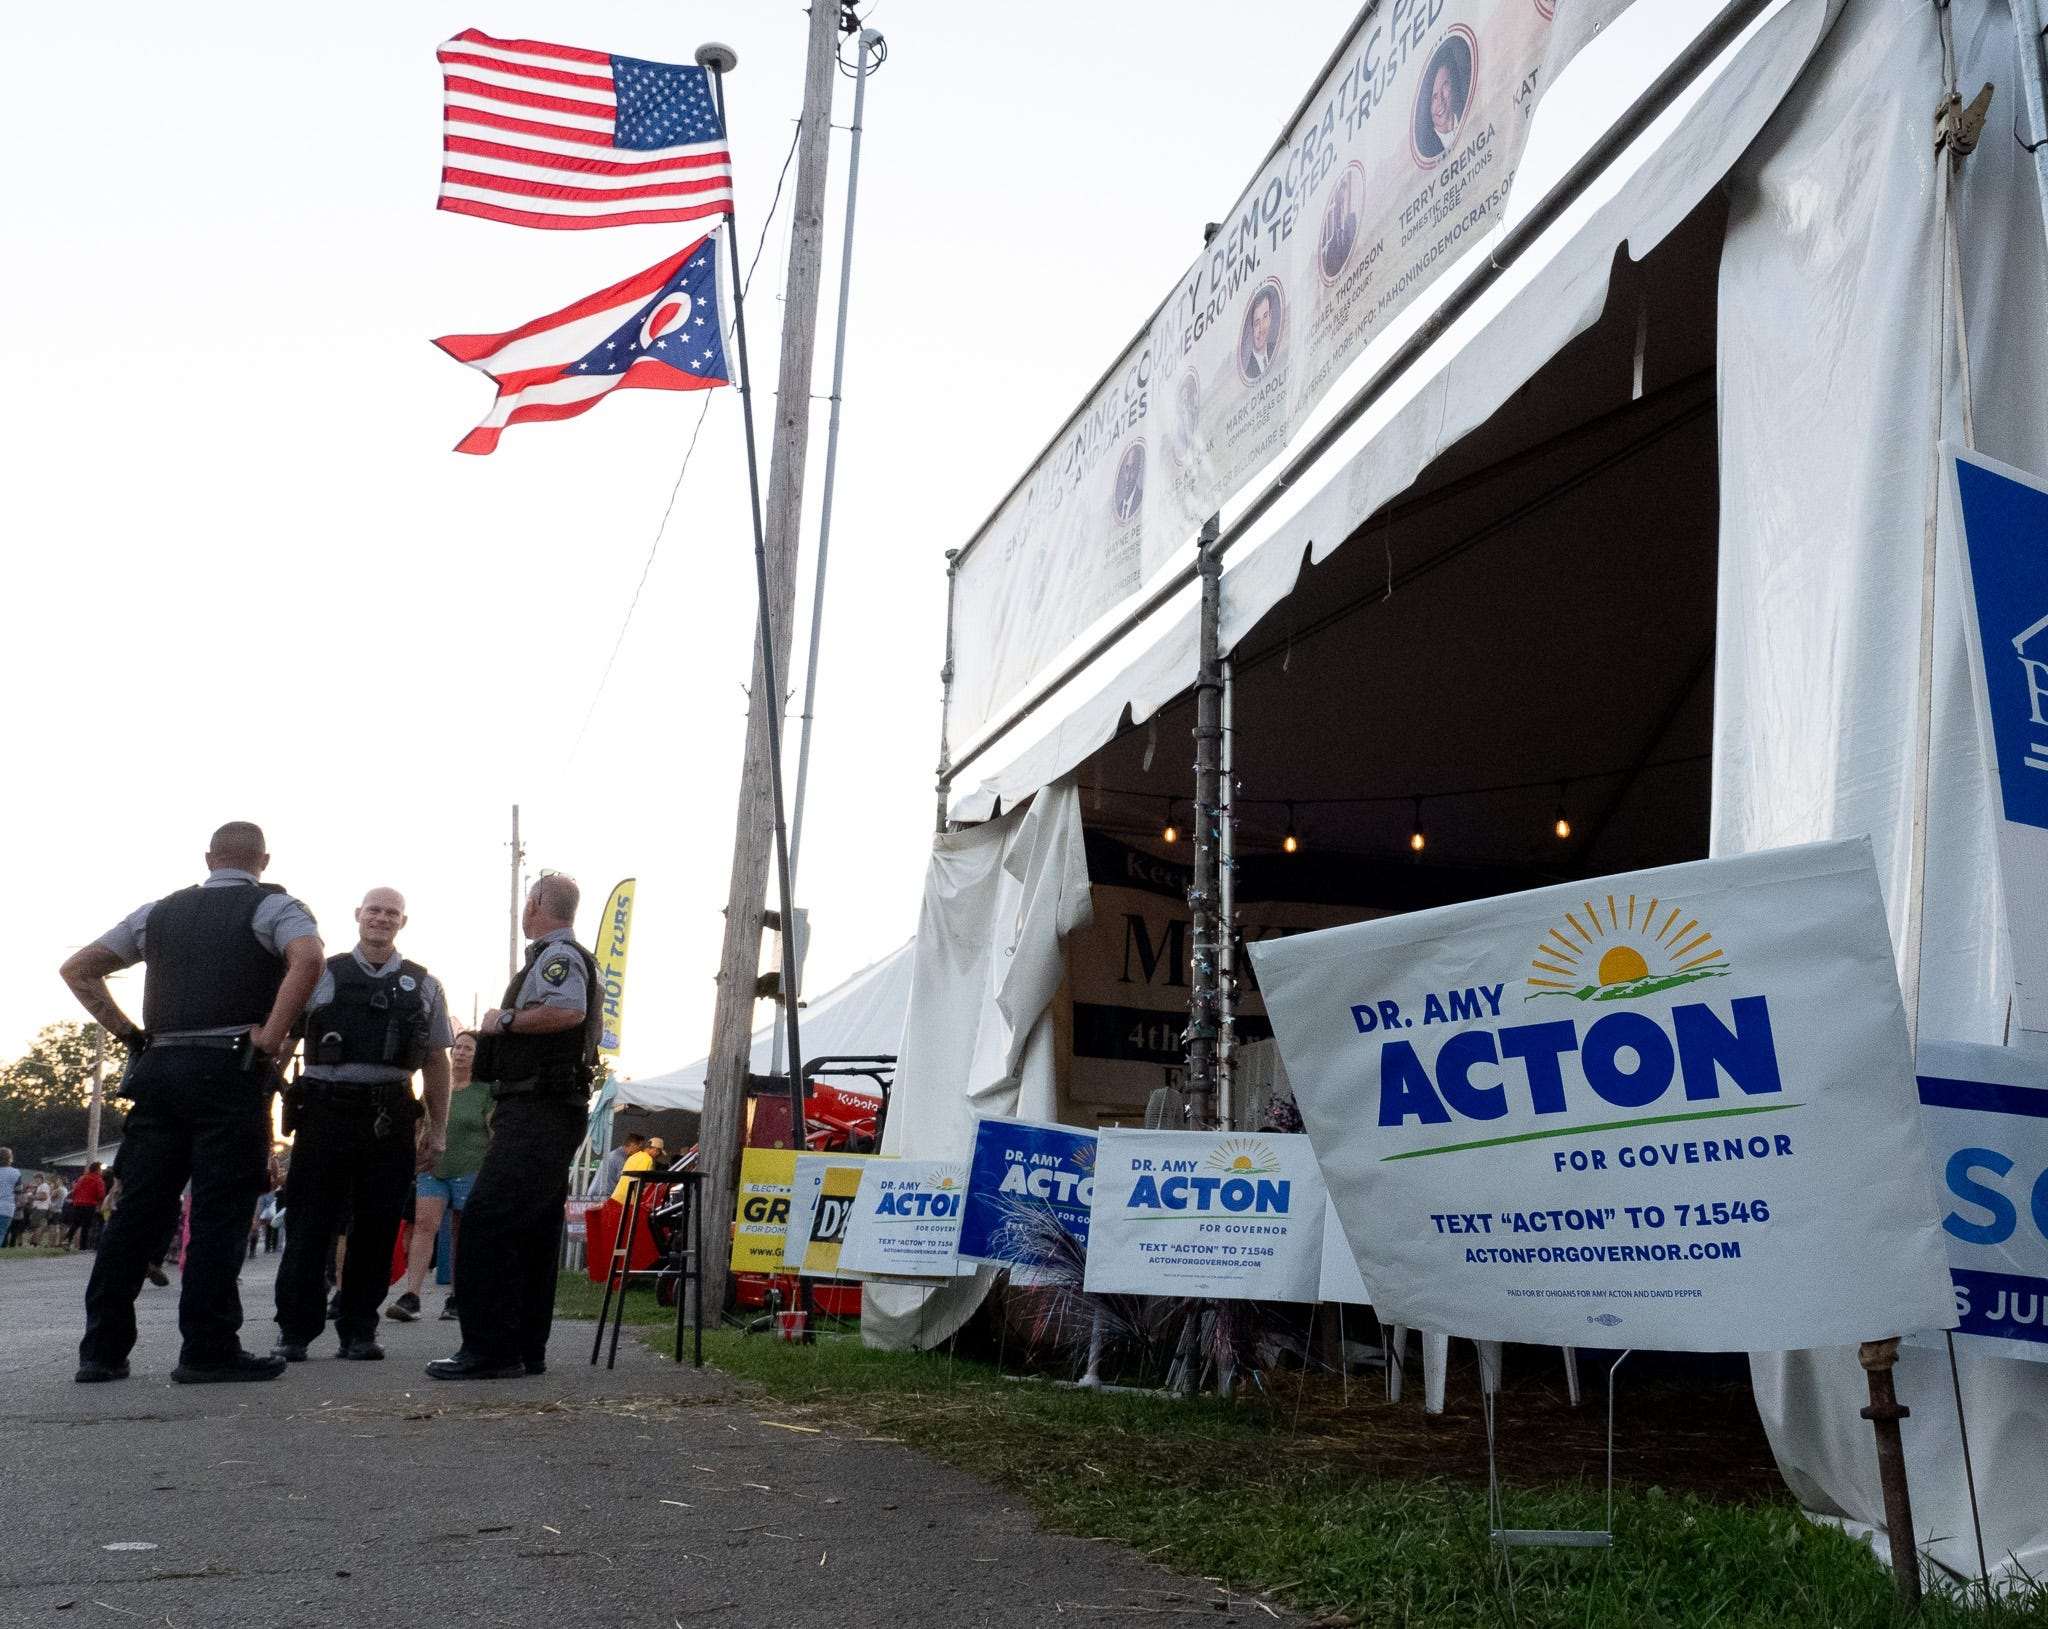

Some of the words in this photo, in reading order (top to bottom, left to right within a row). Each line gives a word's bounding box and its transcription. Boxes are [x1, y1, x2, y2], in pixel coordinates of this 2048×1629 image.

[1399, 180, 1436, 229] TERRY
[1440, 122, 1495, 187] GRENGA
[1125, 271, 1202, 402] COUNTY
[1211, 26, 1381, 293] DEMOCRATIC
[1268, 142, 1337, 252] TESTED.
[1401, 199, 1441, 247] DOMESTIC
[1443, 149, 1493, 204] RELATIONS
[1432, 193, 1462, 228] JUDGE
[1336, 238, 1384, 304] THOMPSON
[1352, 271, 1374, 303] COURT
[1332, 333, 1354, 363] MORE
[1355, 307, 1376, 342] INFO:
[1226, 402, 1248, 435] MARK
[610, 893, 630, 957] TUBS
[604, 963, 623, 1018] HOT
[1350, 999, 1413, 1034] DR.
[1423, 983, 1505, 1025] AMY
[1127, 1021, 1182, 1053] 4th
[1378, 994, 1782, 1127] ACTON
[838, 1092, 879, 1112] Kubota
[1005, 1149, 1027, 1163] DR.
[1029, 1153, 1063, 1168] AMY
[1131, 1158, 1157, 1172] DR.
[1161, 1159, 1198, 1173] AMY
[1554, 1149, 1607, 1173] FOR
[1618, 1134, 1794, 1168] GOVERNOR
[751, 1184, 777, 1193] ELECT
[881, 1181, 896, 1190] DR.
[898, 1181, 921, 1190] AMY
[1127, 1175, 1291, 1214] ACTON
[1942, 1147, 2048, 1245] S
[745, 1225, 764, 1233] FOR
[1058, 1212, 1075, 1222] FOR
[1200, 1224, 1221, 1233] FOR
[1225, 1225, 1288, 1235] GOVERNOR
[1431, 1213, 1493, 1234] TEXT
[1625, 1206, 1665, 1229] TO
[1674, 1199, 1770, 1227] 71546
[1139, 1243, 1167, 1252] TEXT
[1222, 1246, 1237, 1255] TO
[1240, 1246, 1274, 1256] 71546
[1148, 1256, 1261, 1267] ACTONFORGOVERNOR.COM
[1465, 1241, 1741, 1264] ACTONFORGOVERNOR.COM
[1507, 1289, 1522, 1297] PAID
[1522, 1290, 1536, 1298] FOR
[1536, 1290, 1545, 1298] BY
[1545, 1290, 1577, 1298] OHIOANS
[1577, 1290, 1591, 1298] FOR
[1592, 1290, 1608, 1298] AMY
[1608, 1290, 1632, 1298] ACTON
[1633, 1290, 1650, 1298] AND
[1650, 1290, 1673, 1298] DAVID
[1674, 1290, 1702, 1298] PEPPER
[1985, 1291, 2048, 1326] JU
